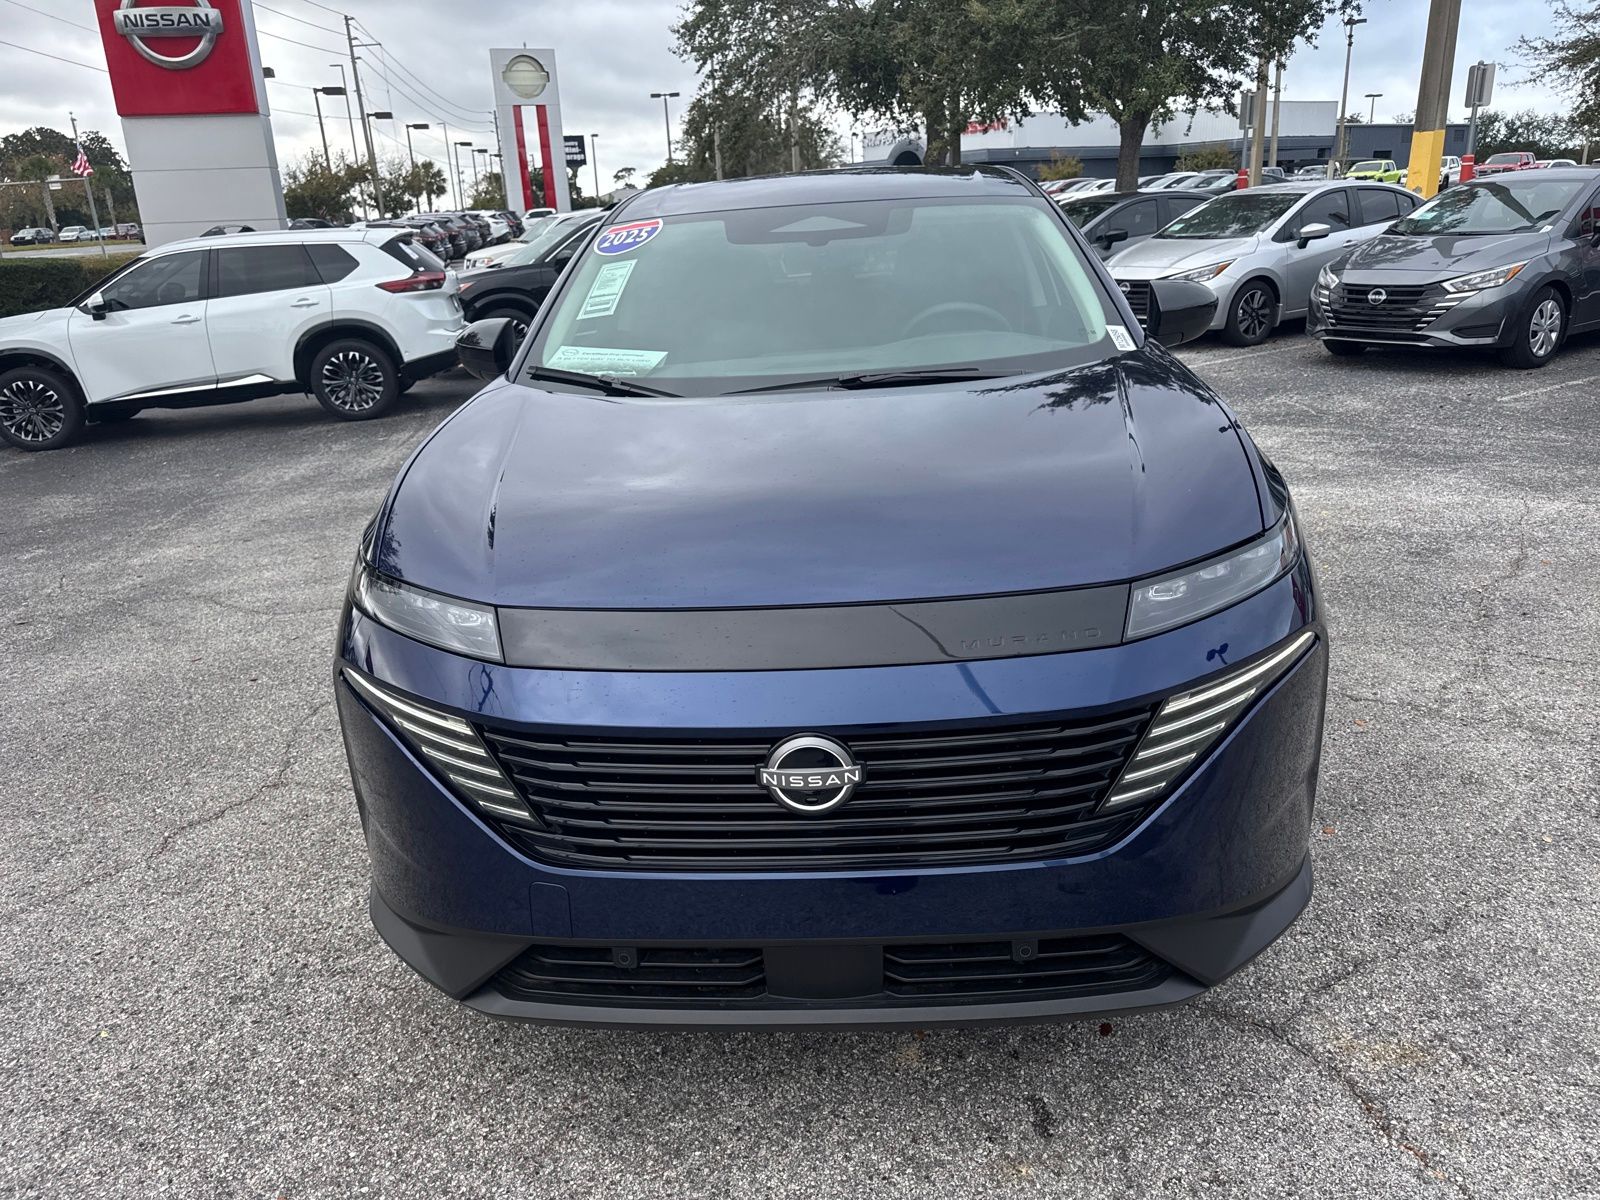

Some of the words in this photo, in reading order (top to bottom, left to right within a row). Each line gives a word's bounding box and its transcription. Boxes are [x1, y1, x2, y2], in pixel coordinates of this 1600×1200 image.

[123, 13, 211, 28] NISSAN
[600, 227, 652, 248] 2025
[960, 627, 1101, 650] MURANO
[762, 770, 860, 787] NISSAN
